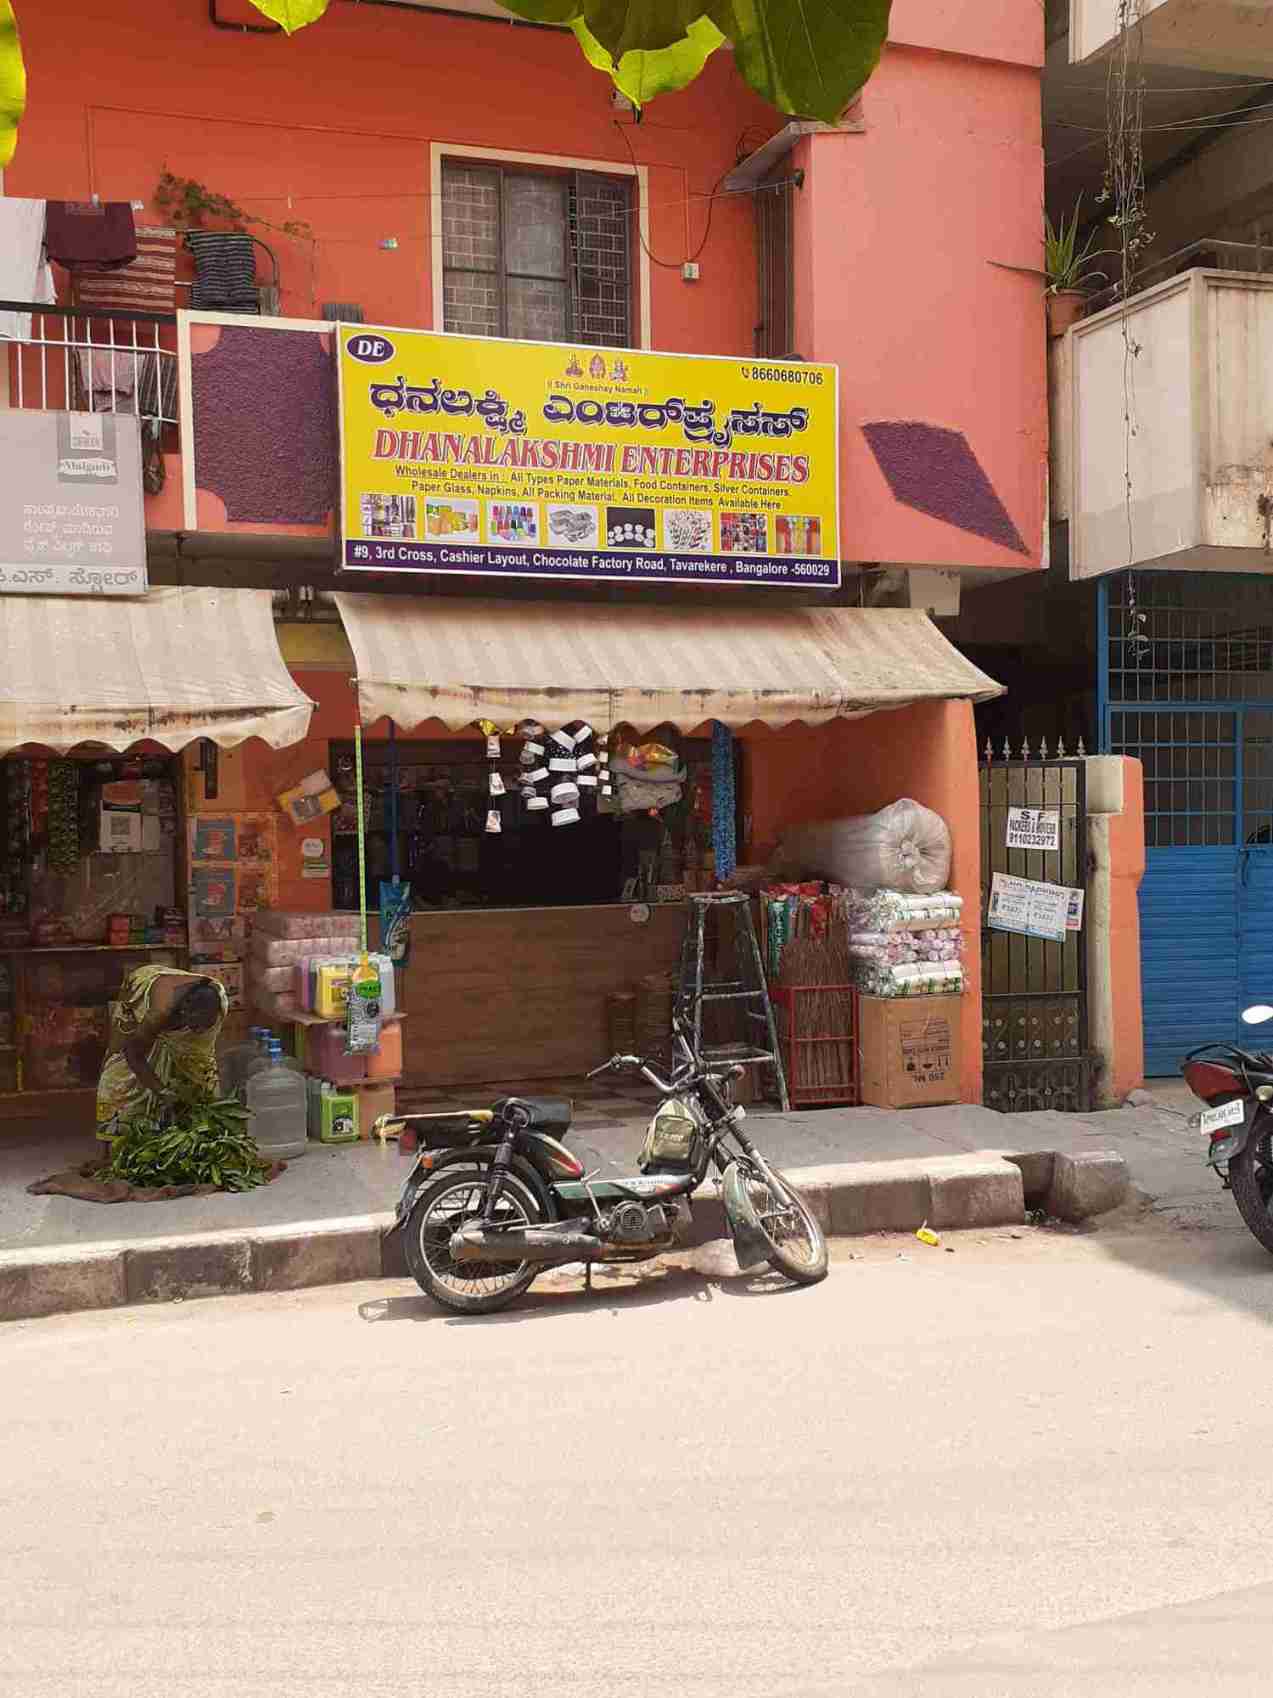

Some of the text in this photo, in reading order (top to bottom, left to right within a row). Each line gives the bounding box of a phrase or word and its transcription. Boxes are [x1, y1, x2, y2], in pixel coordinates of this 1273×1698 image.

[357, 340, 386, 357] DE
[752, 366, 824, 385] 8660680706
[370, 375, 527, 435] ಧನಲಕ್ಷ್ಮಿ
[373, 429, 810, 483] DHANALAKSHMI ENTERPRISES
[395, 464, 447, 478] Wholesale
[450, 467, 486, 480] Dealers
[511, 472, 523, 482] All
[527, 472, 554, 486] Types
[557, 475, 585, 487] Paper
[634, 479, 657, 489] Food
[713, 482, 739, 494] Silver
[411, 479, 440, 493] Paper
[522, 487, 535, 497] All
[537, 488, 576, 501] Packing
[623, 492, 635, 503] All
[637, 493, 686, 505] Decoration
[689, 495, 713, 506] Items
[719, 497, 758, 509] Available
[760, 499, 781, 510] Here
[354, 545, 373, 560] #9,
[375, 546, 395, 560] 3rd
[399, 547, 437, 562] Cross,
[440, 549, 484, 564] Cashier
[488, 551, 530, 567] Layout,
[533, 553, 588, 568] Chocolate
[592, 556, 632, 572] Factory
[636, 557, 667, 571] Road,
[736, 561, 788, 577] Bangalore
